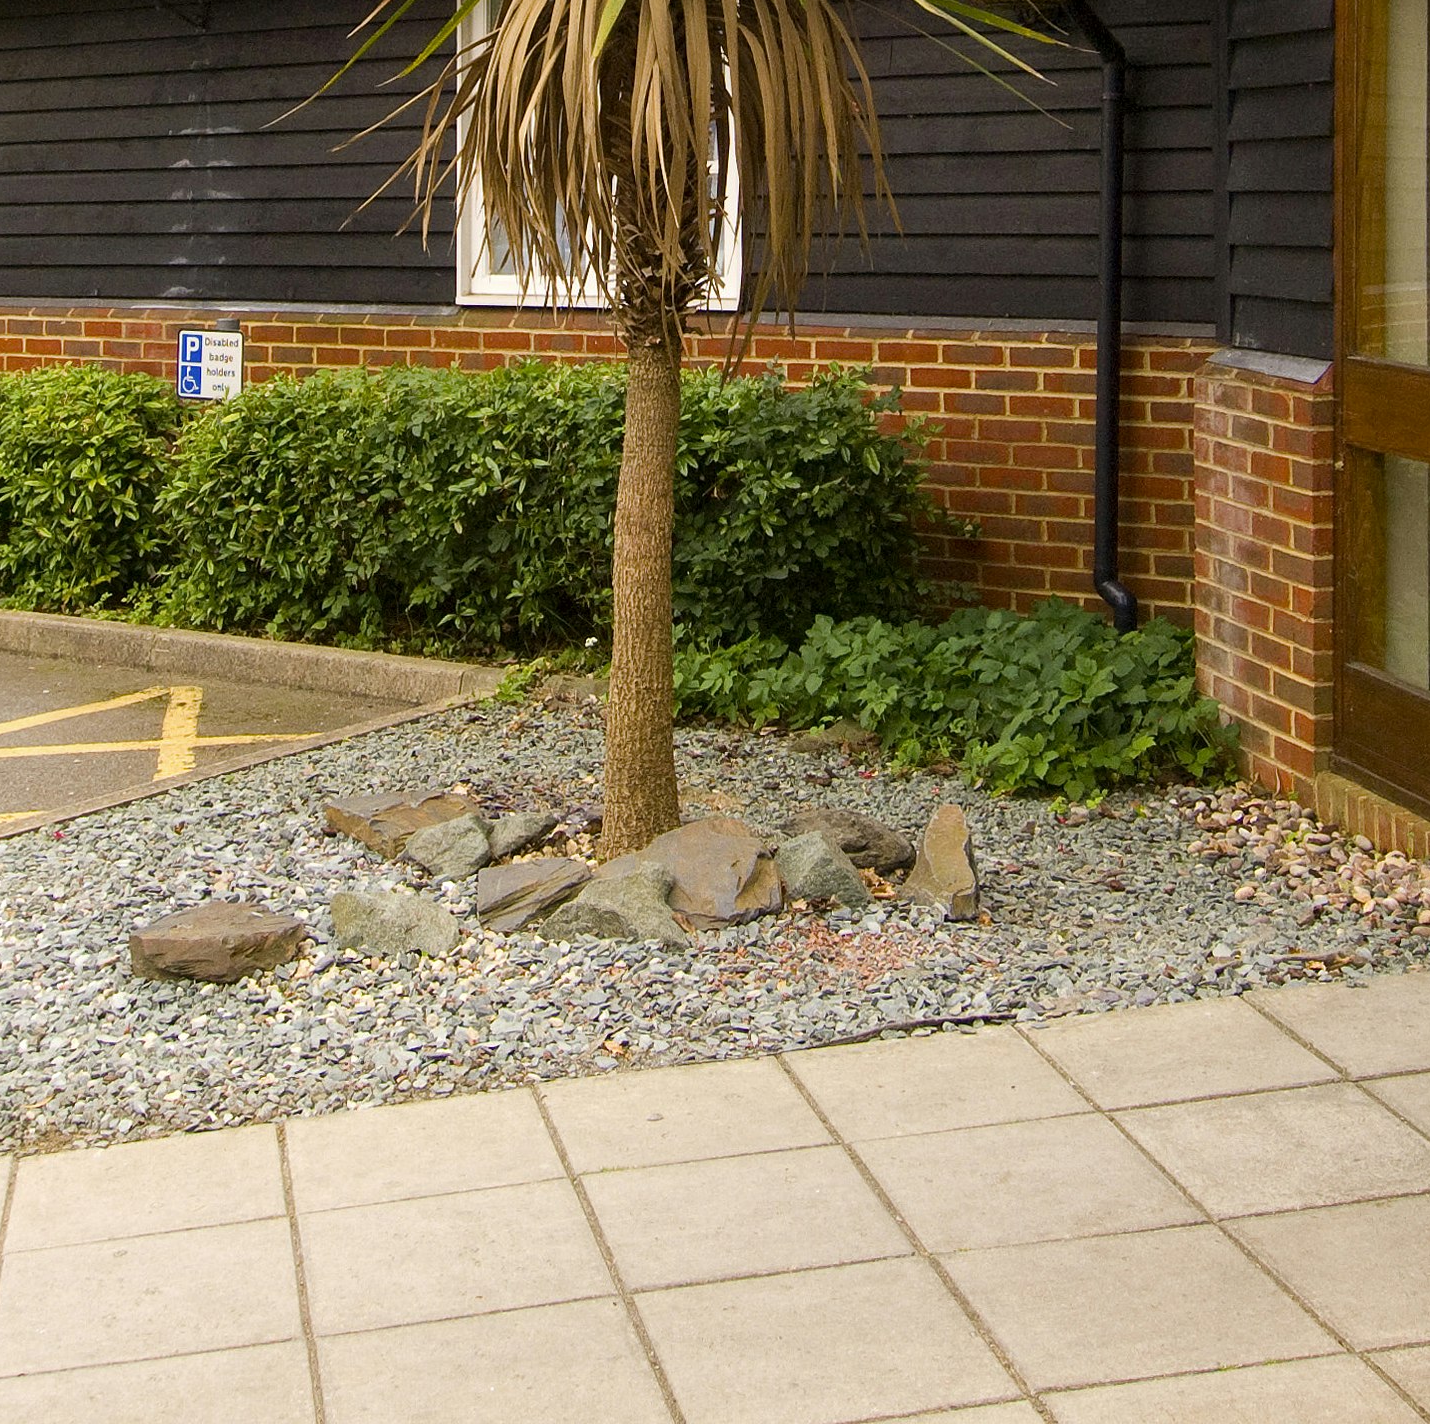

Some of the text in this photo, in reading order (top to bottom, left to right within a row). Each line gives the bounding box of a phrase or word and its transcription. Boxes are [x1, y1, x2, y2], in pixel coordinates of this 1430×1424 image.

[204, 337, 239, 348] Disabled
[186, 336, 200, 361] P
[209, 353, 234, 364] badge
[206, 367, 236, 377] holders
